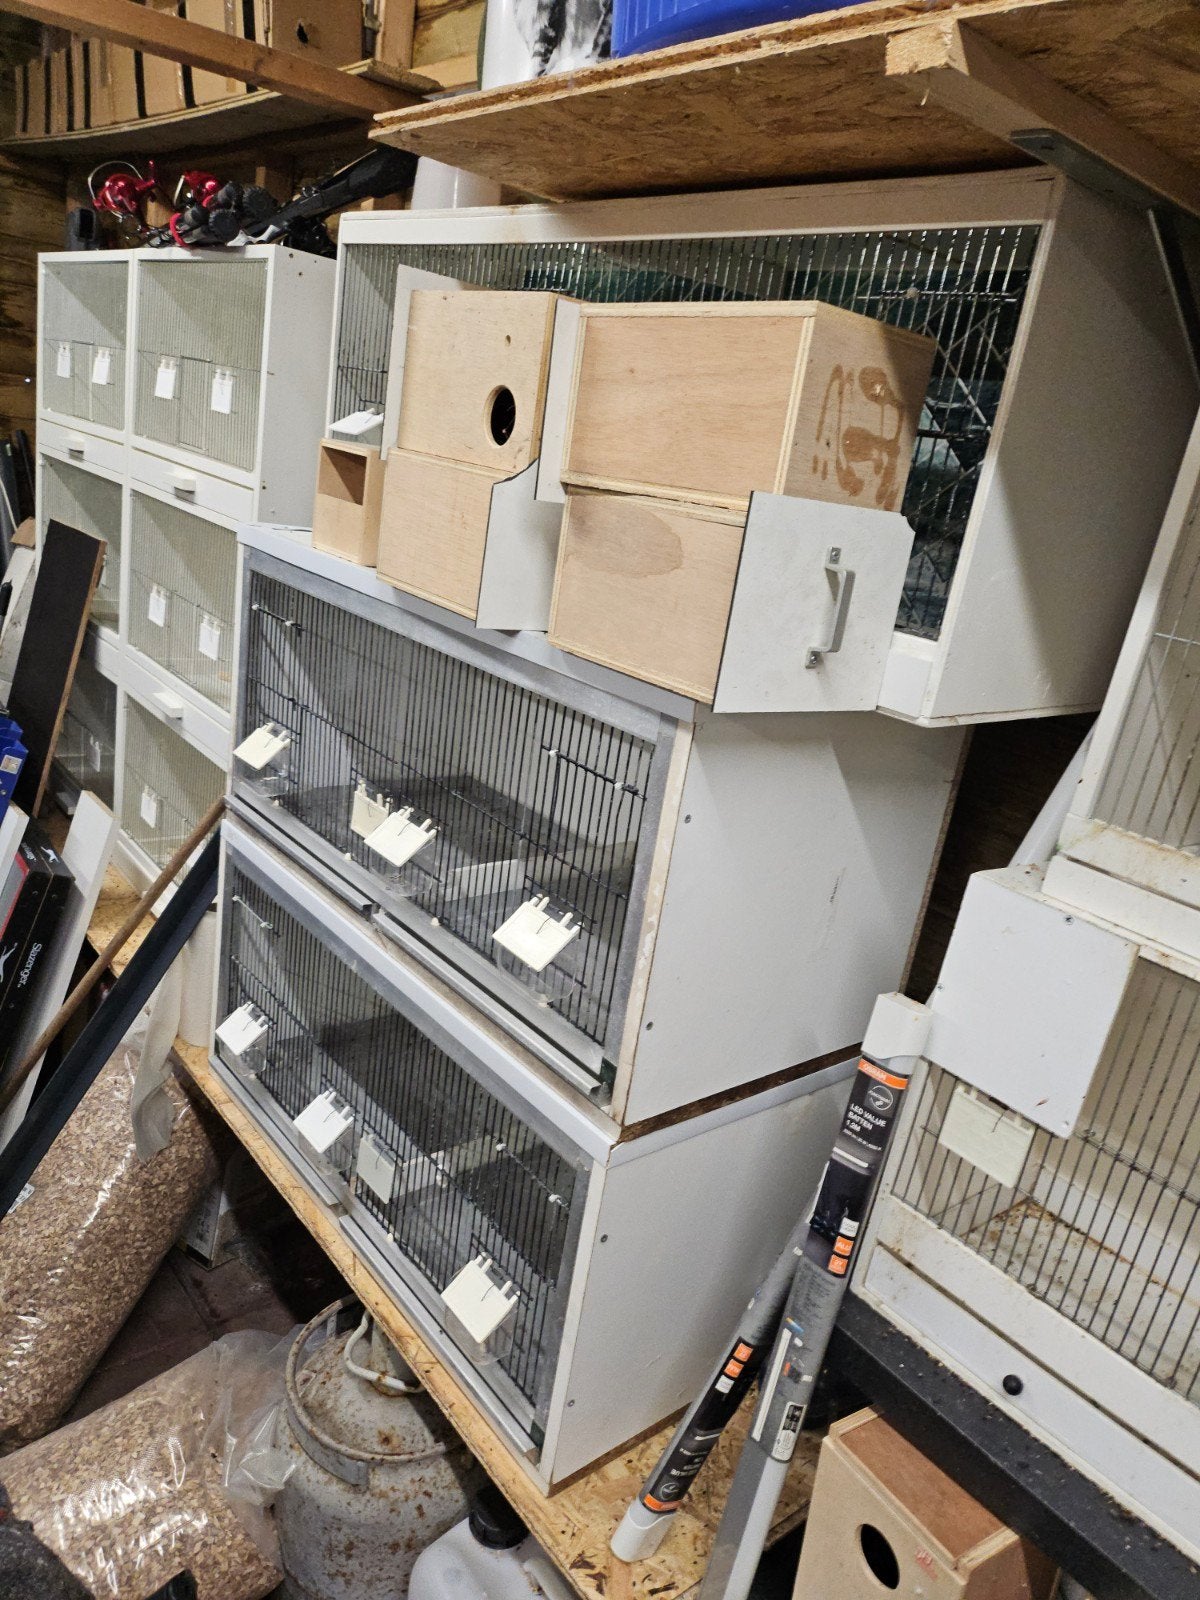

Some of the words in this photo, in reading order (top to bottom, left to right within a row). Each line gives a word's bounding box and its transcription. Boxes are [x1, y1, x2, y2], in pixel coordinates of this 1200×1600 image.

[19, 942, 42, 985] Slazenger
[850, 1103, 864, 1115] LED
[864, 1110, 887, 1128] VALUE
